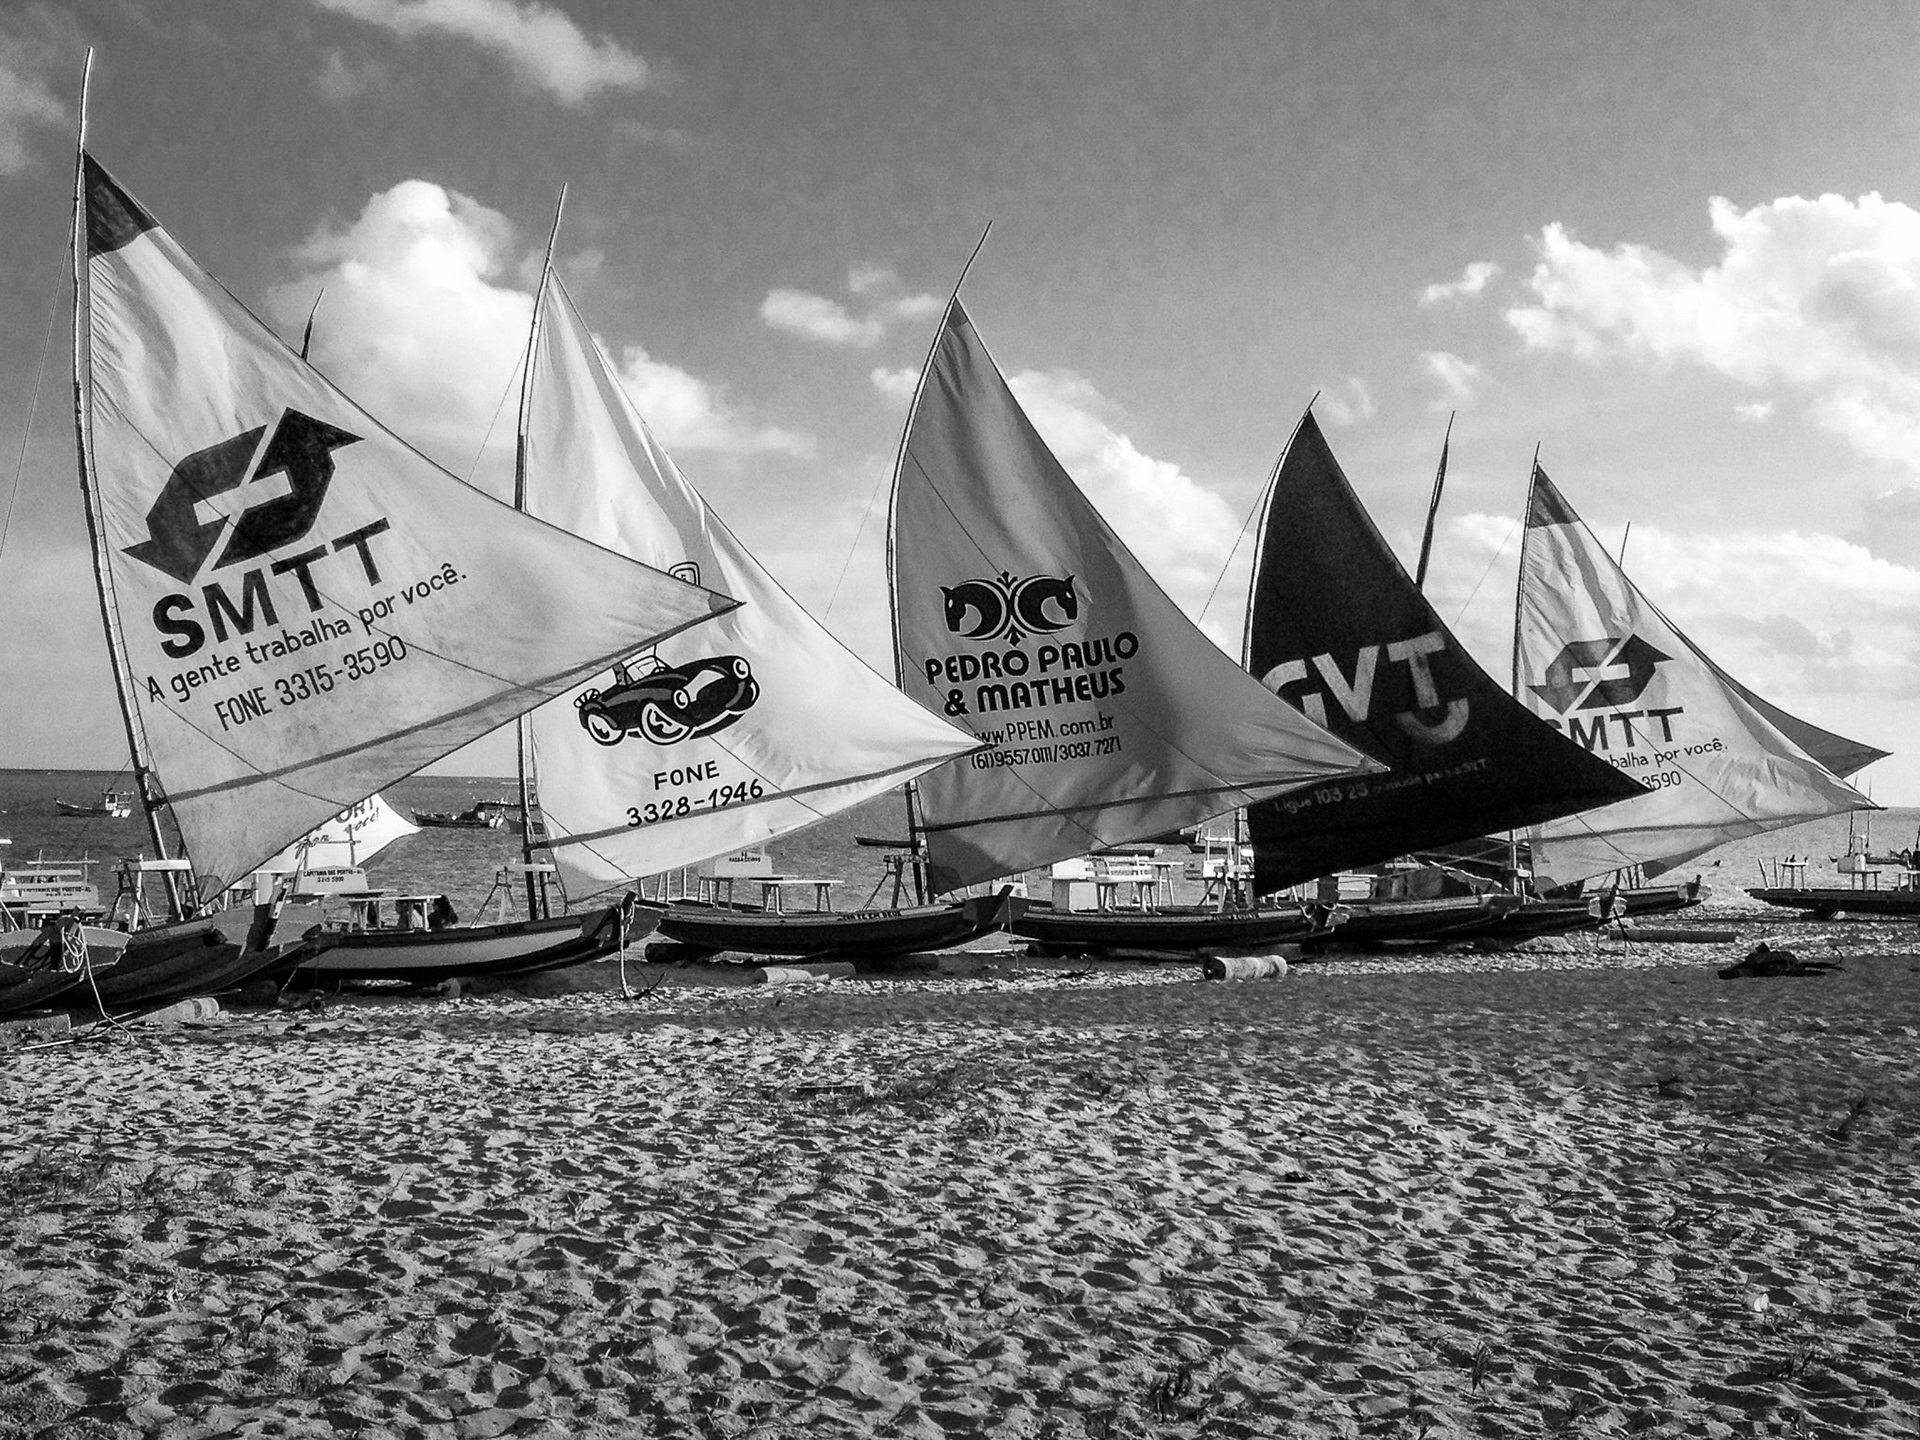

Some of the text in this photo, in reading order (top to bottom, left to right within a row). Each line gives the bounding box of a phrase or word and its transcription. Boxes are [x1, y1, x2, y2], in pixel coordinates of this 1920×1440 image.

[152, 517, 391, 659] SMTT
[146, 562, 467, 703] A gente trabalha por você.
[214, 634, 407, 731] FONE 3315-3590
[925, 631, 1139, 685] PEDRO PAULO
[944, 667, 1126, 717] & MATHEUS
[1542, 706, 1684, 751] MTT
[1654, 749, 1681, 768] por
[1683, 738, 1728, 756] você.
[654, 760, 720, 791] FONE
[626, 778, 764, 828] 3328-1946
[1275, 798, 1312, 815] Ligue
[1314, 787, 1343, 805] 103
